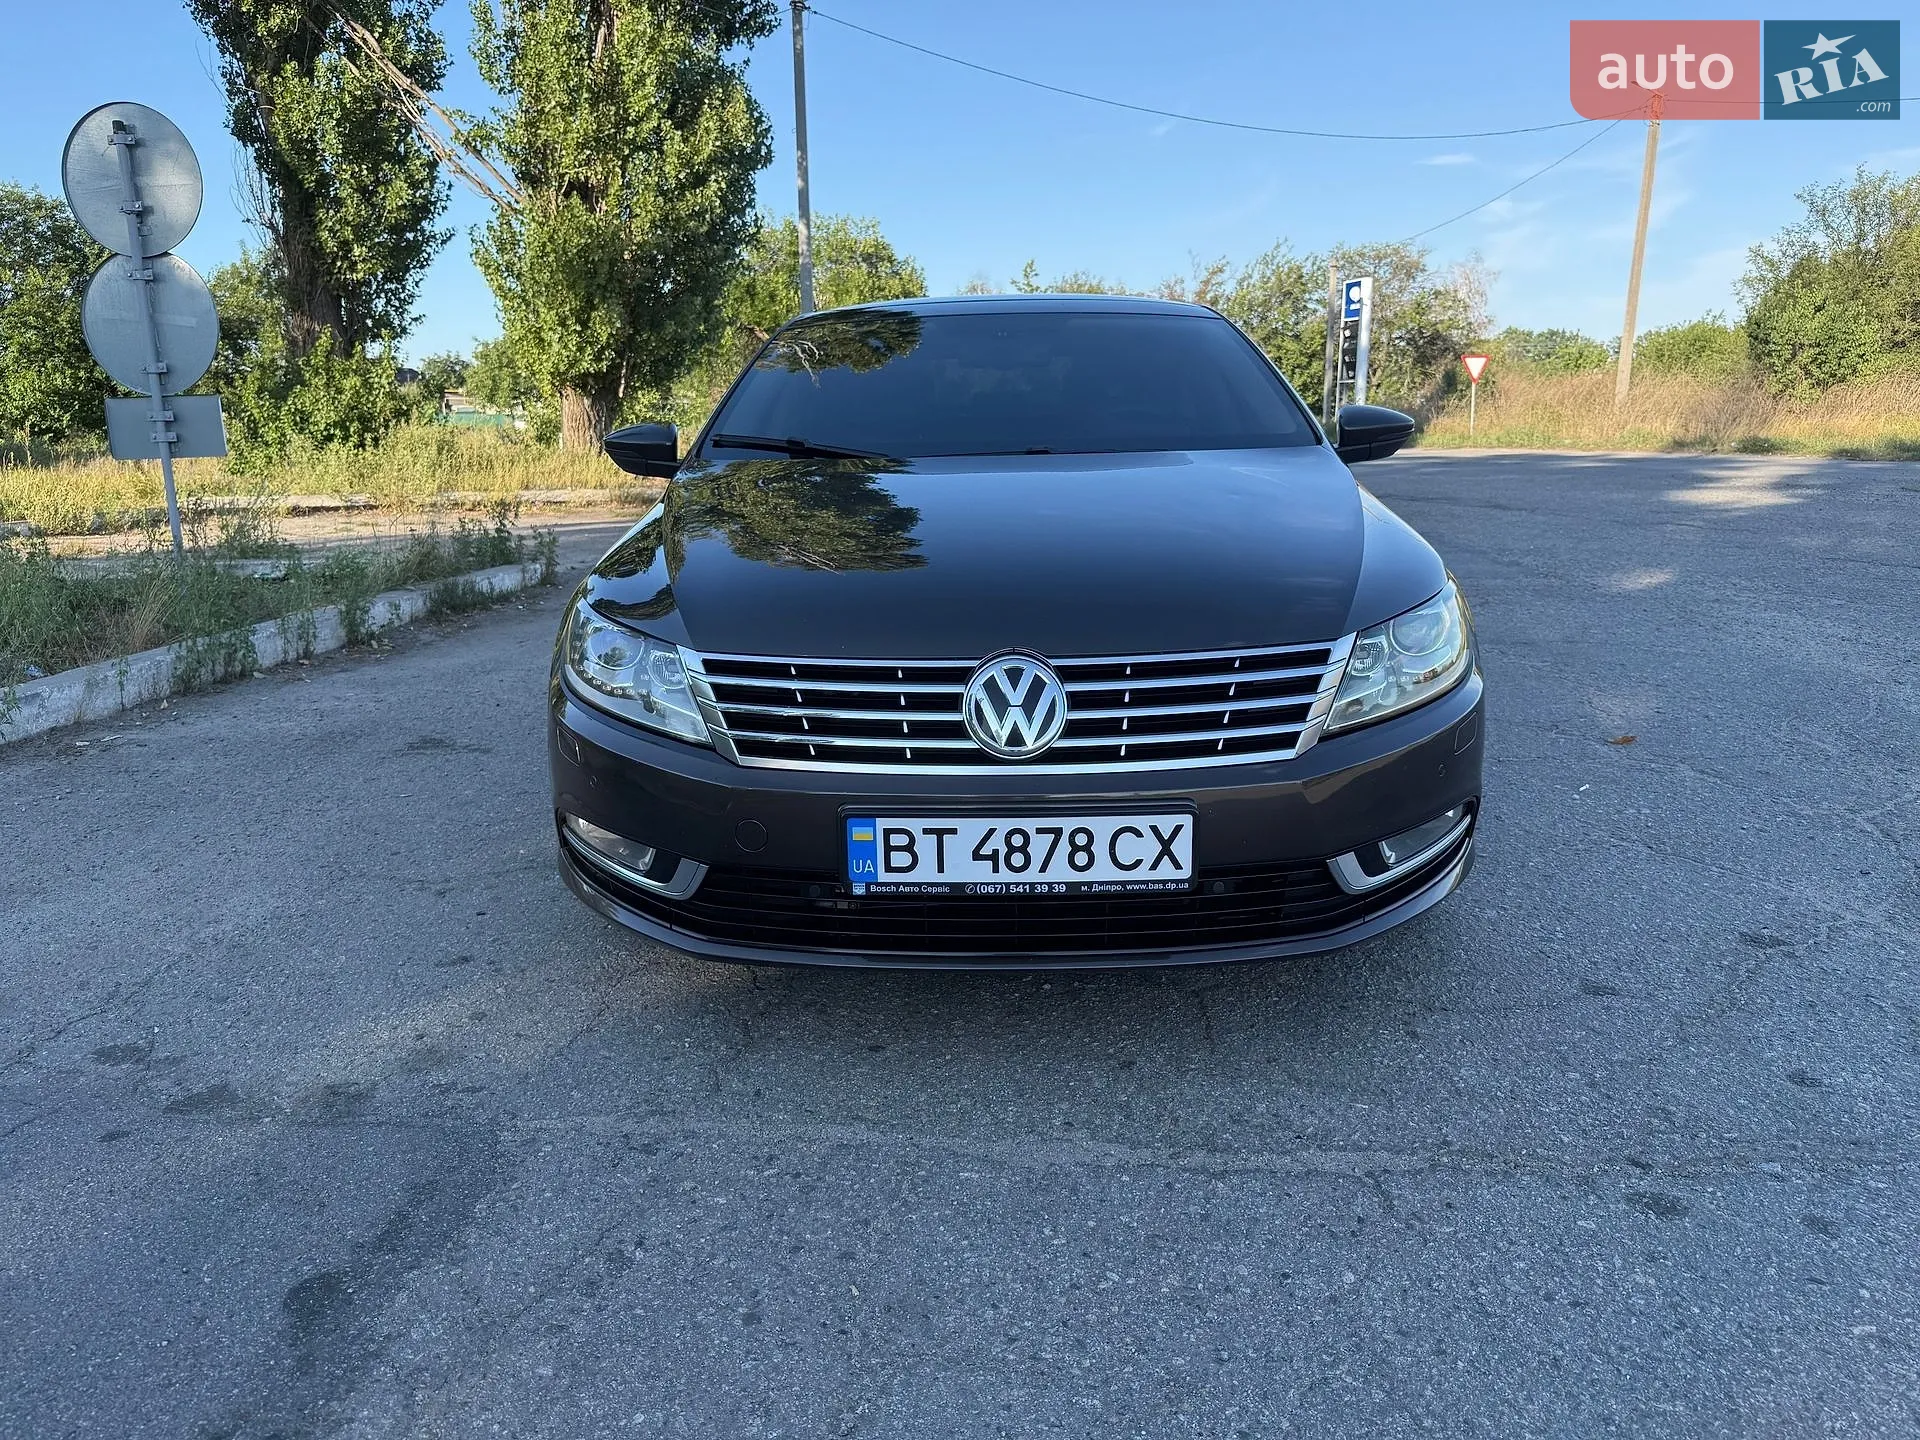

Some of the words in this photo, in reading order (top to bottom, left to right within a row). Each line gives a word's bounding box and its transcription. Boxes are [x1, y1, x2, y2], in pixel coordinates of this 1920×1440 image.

[883, 828, 958, 873] BT
[971, 826, 1096, 874] 4878
[1108, 823, 1185, 872] CX
[853, 860, 875, 874] UA
[870, 884, 897, 893] Bosch
[976, 883, 1006, 894] (067)
[1009, 884, 1030, 893] 541
[1034, 883, 1049, 893] 39
[1051, 883, 1066, 893] 39
[1126, 881, 1189, 891] www.bas.dp.ua
